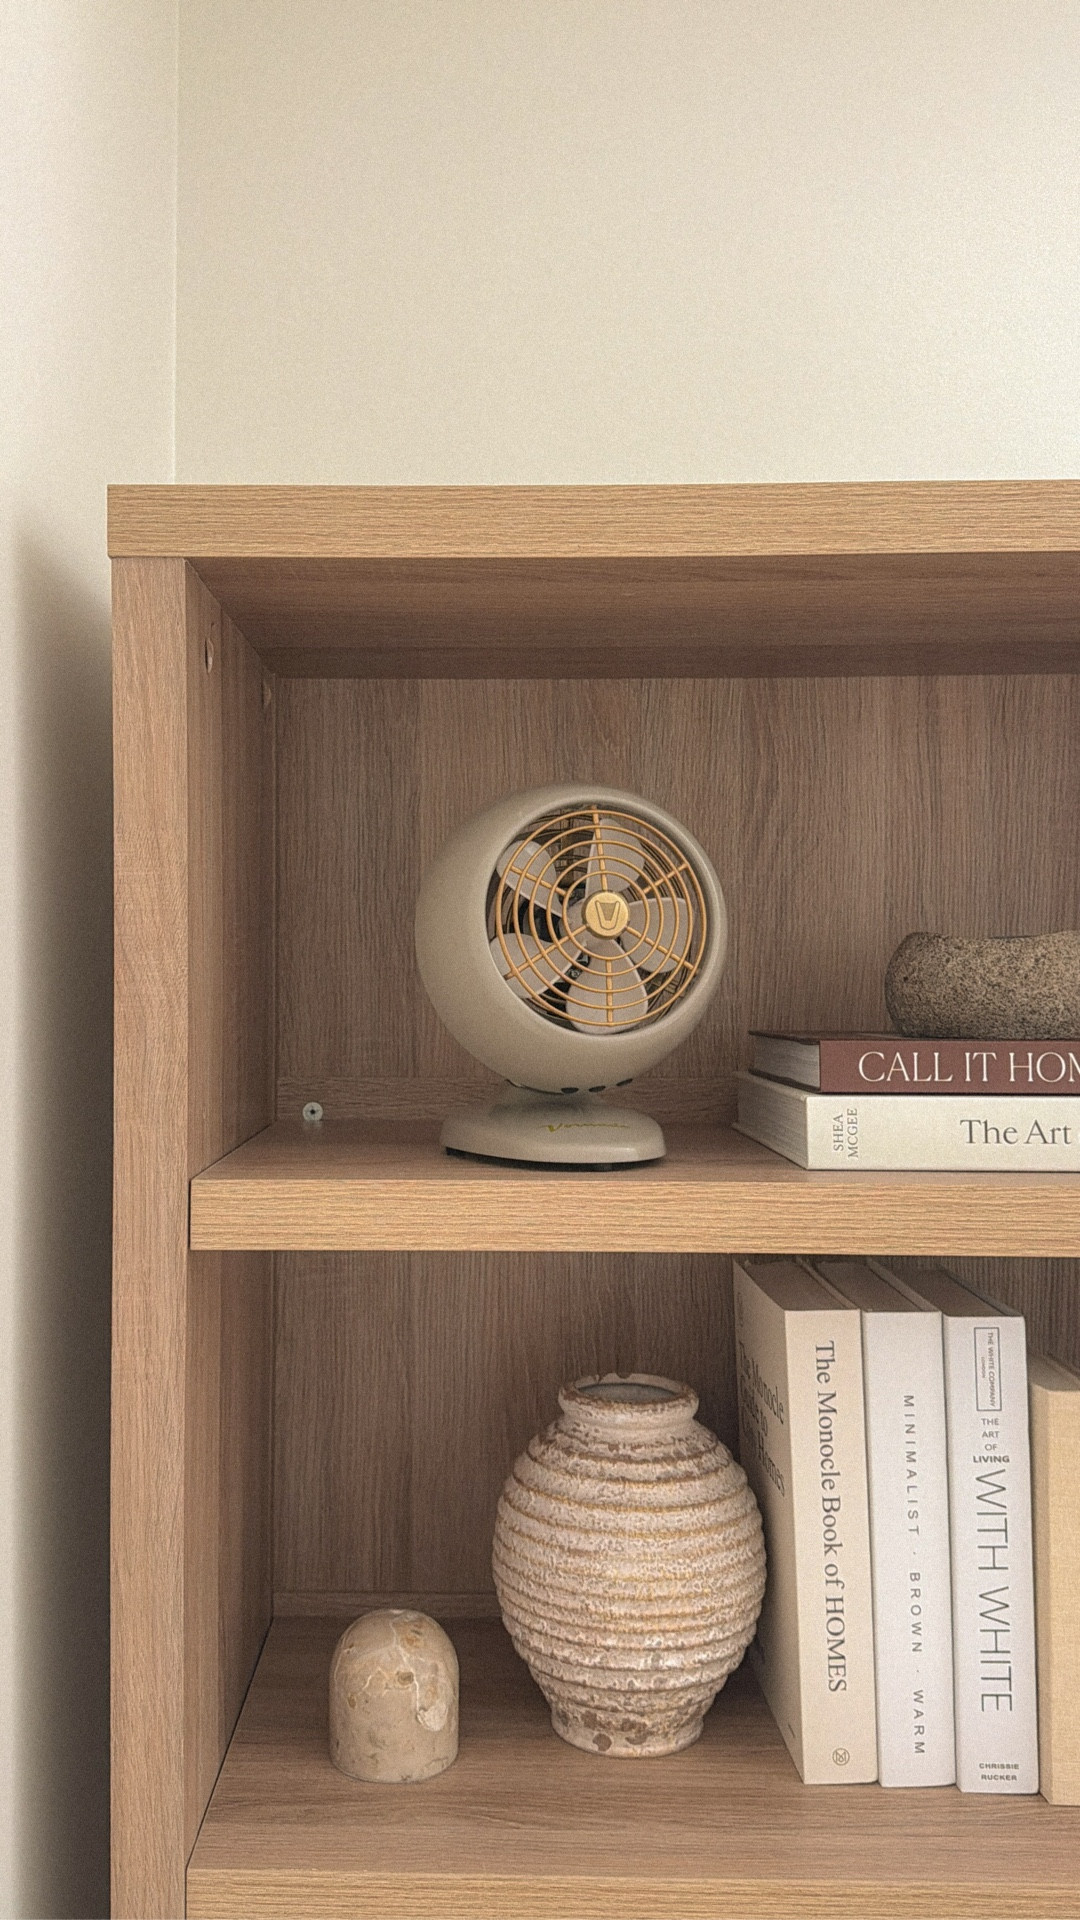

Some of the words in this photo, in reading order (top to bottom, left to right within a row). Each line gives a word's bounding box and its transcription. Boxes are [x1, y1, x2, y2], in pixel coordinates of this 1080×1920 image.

[858, 1051, 953, 1082] CALL
[965, 1051, 997, 1082] IT
[832, 1113, 844, 1151] SHEA
[847, 1108, 859, 1158] MCGEE
[960, 1118, 1018, 1145] The
[1023, 1118, 1072, 1145] Art
[815, 1340, 835, 1384] The
[751, 1357, 784, 1425] Monocle
[988, 1371, 996, 1407] COMPANY
[816, 1391, 841, 1491] Monocle
[981, 1418, 1000, 1426] THE
[903, 1395, 919, 1535] MINIMALIST
[973, 1455, 1010, 1463] LIVING
[984, 1443, 998, 1451] OF
[821, 1496, 844, 1557] Book
[975, 1468, 1009, 1570] WITH
[823, 1563, 845, 1589] of
[909, 1572, 923, 1653] BROWN
[825, 1597, 848, 1692] HOMES
[978, 1586, 1012, 1712] WHITE
[912, 1689, 925, 1754] WARM
[978, 1762, 1020, 1770] CHRISSIE
[980, 1773, 1018, 1781] RUCKER
